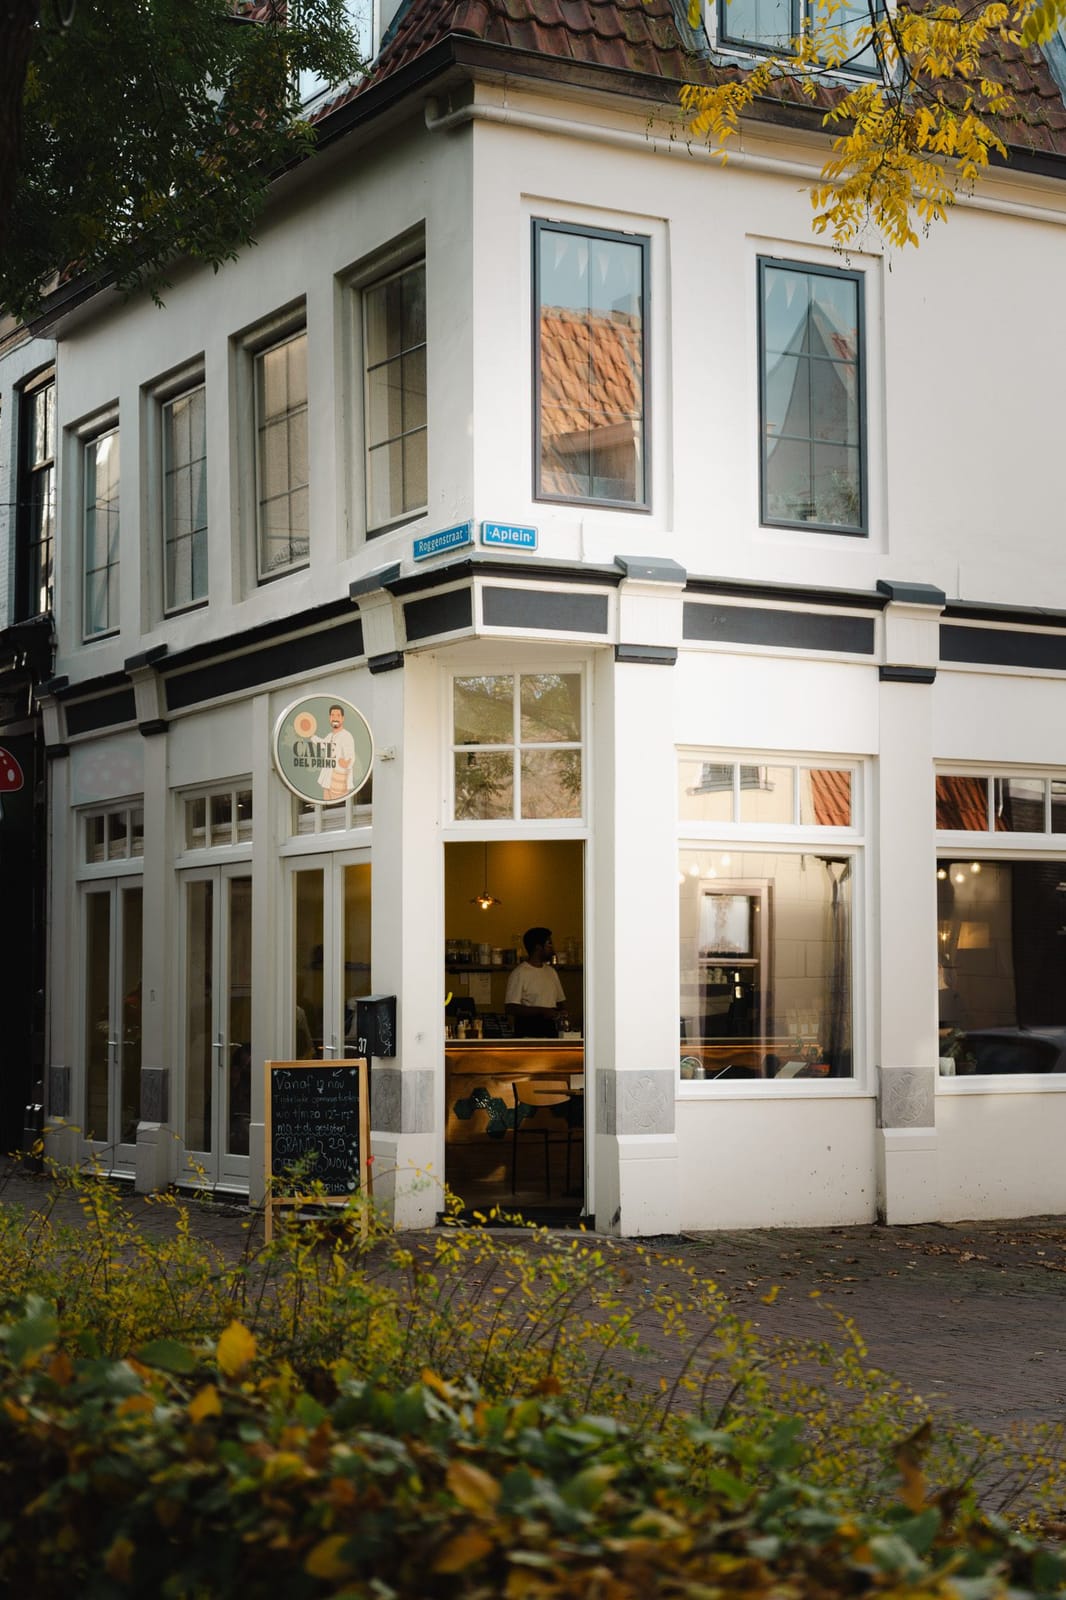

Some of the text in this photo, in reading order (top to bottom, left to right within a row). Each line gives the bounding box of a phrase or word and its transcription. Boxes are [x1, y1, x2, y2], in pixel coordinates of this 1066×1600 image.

[418, 530, 463, 553] Roggenstraat
[492, 527, 531, 543] Aplein
[294, 758, 337, 769] DEL PRIMO
[358, 1037, 368, 1054] 37
[275, 1074, 314, 1093] Vanaf
[327, 1079, 345, 1089] nov
[328, 1137, 346, 1153] 29
